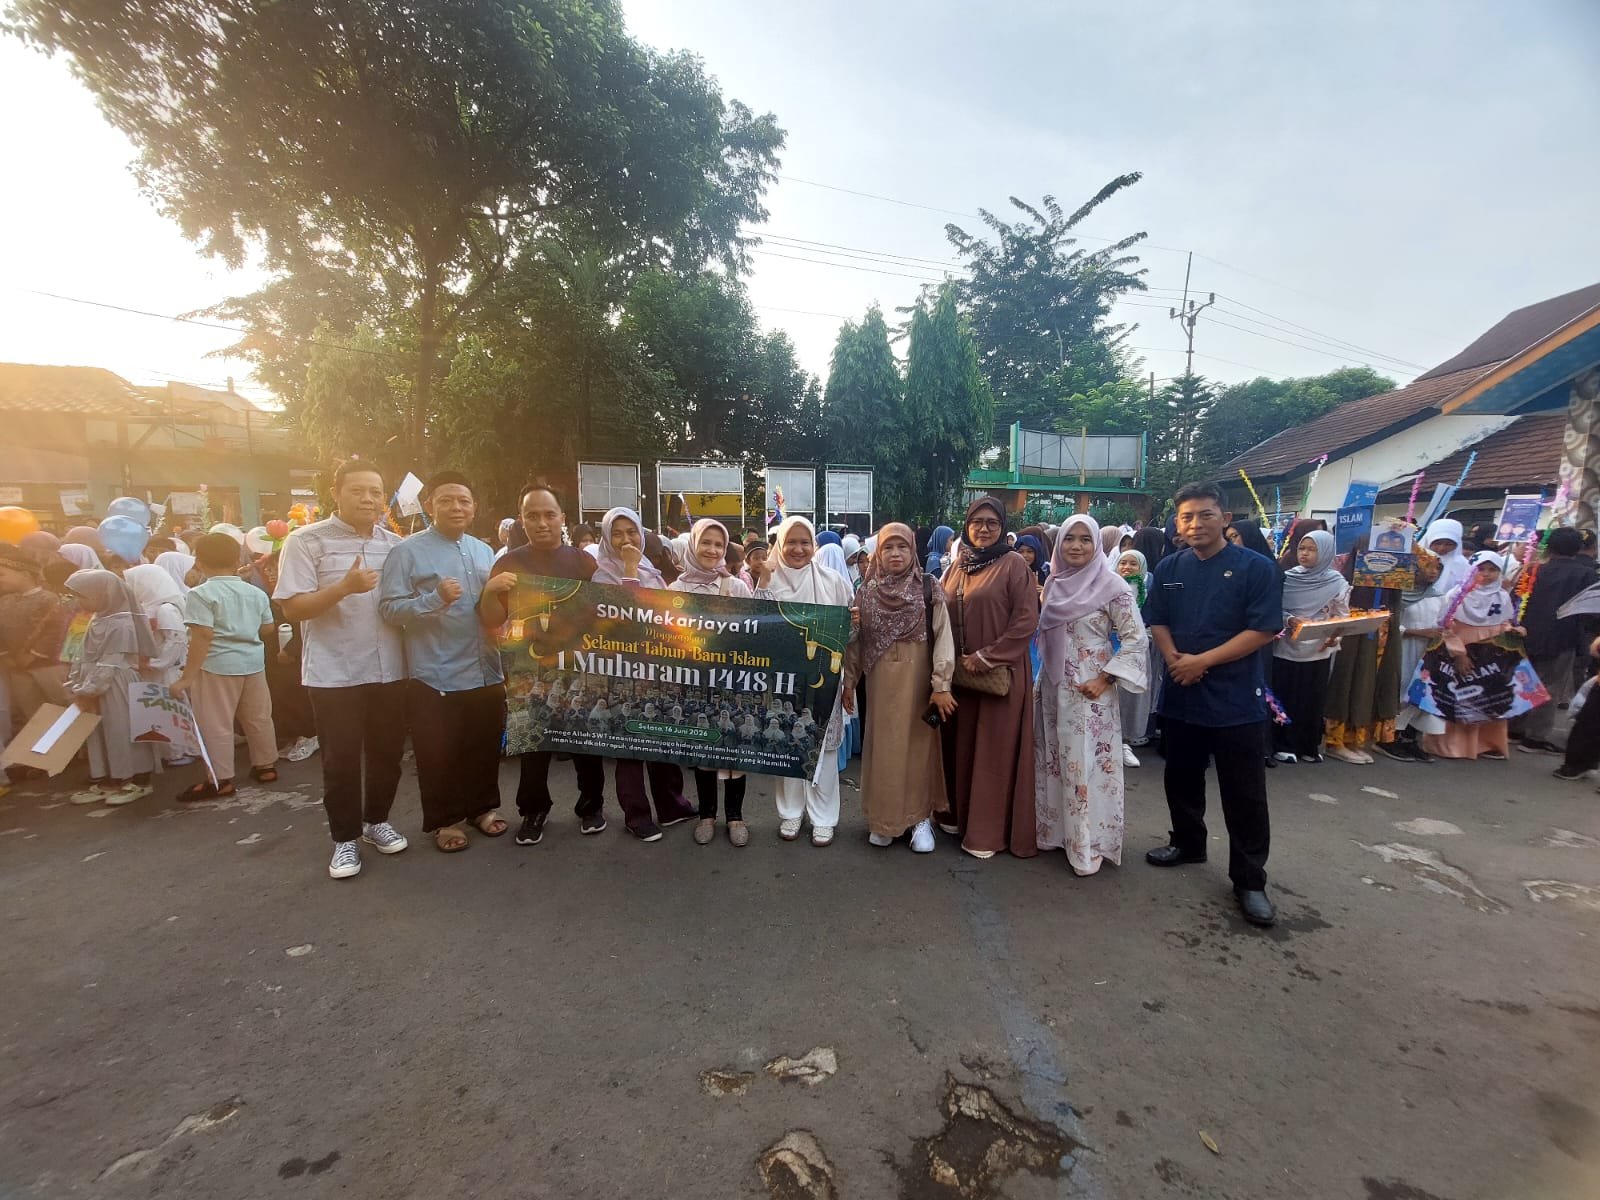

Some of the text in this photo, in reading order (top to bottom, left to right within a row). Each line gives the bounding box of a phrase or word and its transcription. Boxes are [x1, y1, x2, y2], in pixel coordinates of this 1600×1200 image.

[1339, 512, 1364, 524] ISLAM
[596, 603, 759, 635] SDN Mekarjaya 11
[581, 633, 770, 667] Selamat Tahun Baru Islam
[557, 650, 797, 695] 1 Muharam 1448 H
[543, 727, 571, 737] Semoga
[571, 729, 591, 738] Allah
[591, 731, 608, 740] SWT
[664, 726, 673, 734] 16
[673, 727, 689, 735] Juni
[689, 727, 708, 737] 2026
[551, 736, 569, 744] iman
[720, 754, 738, 762] umur
[739, 756, 756, 766] yang
